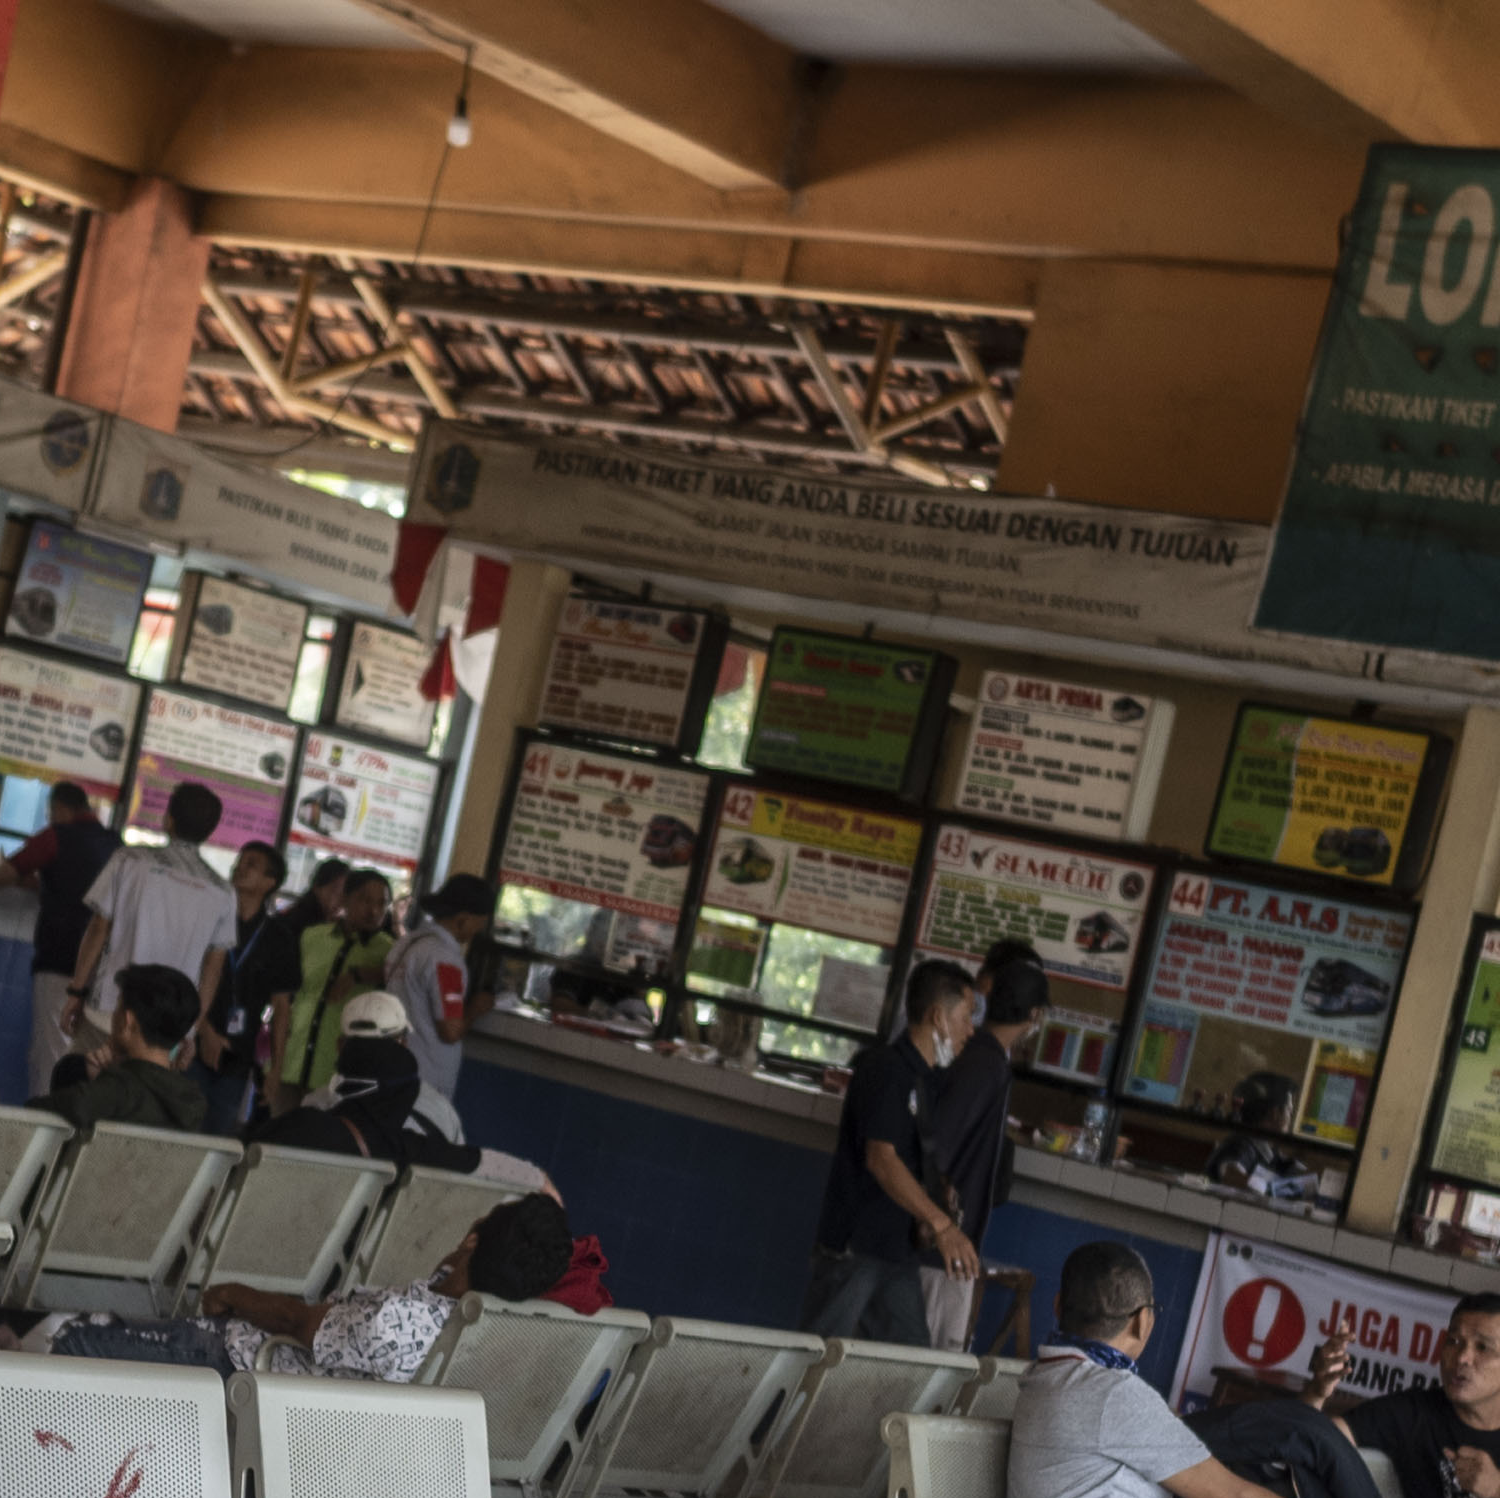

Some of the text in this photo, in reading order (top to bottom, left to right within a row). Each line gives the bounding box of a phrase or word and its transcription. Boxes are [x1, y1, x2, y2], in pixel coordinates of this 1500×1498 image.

[1341, 386, 1438, 426] PASTIKAN
[1438, 397, 1496, 431] TIKET
[1321, 460, 1404, 495] APABILA
[1402, 469, 1488, 505] MERASA
[214, 484, 392, 556] PASTIKAN BUS YANG ANDA
[533, 441, 1240, 571] PASTIKAN TIKET YANG ANDA BELI SESUAI DENGAN TUJUAN
[725, 792, 754, 821] 42
[937, 832, 966, 859] 43
[1171, 877, 1341, 934] 44 PT. A.N.S
[1464, 1029, 1486, 1048] 45
[1318, 1298, 1400, 1357] JAGA
